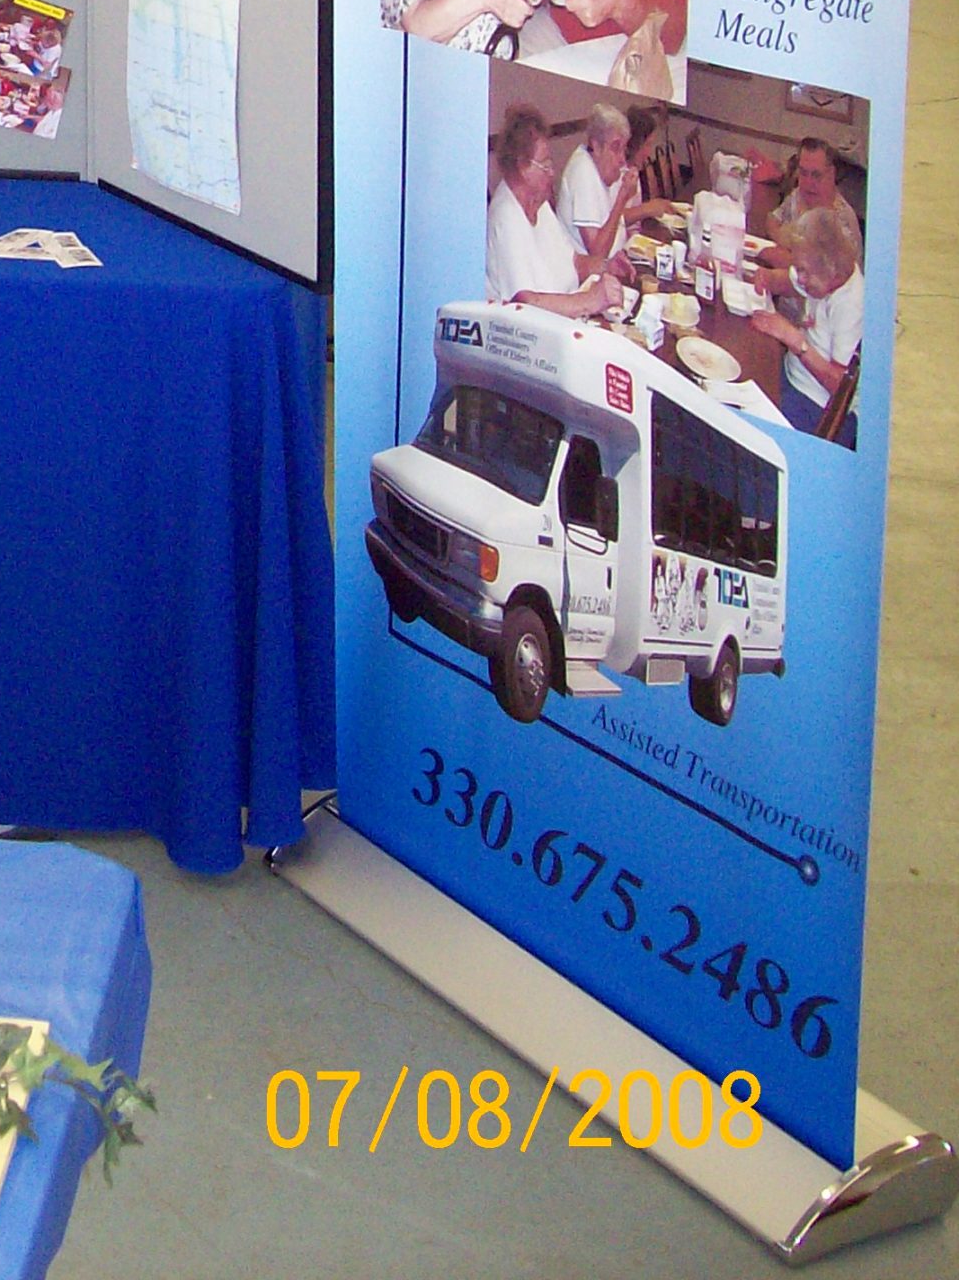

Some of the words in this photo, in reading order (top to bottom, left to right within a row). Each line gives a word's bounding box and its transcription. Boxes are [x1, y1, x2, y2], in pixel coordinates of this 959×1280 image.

[714, 9, 799, 55] Meals
[590, 703, 682, 770] Assisted
[685, 746, 863, 874] Transportation
[411, 746, 841, 1060] 330.675.2486
